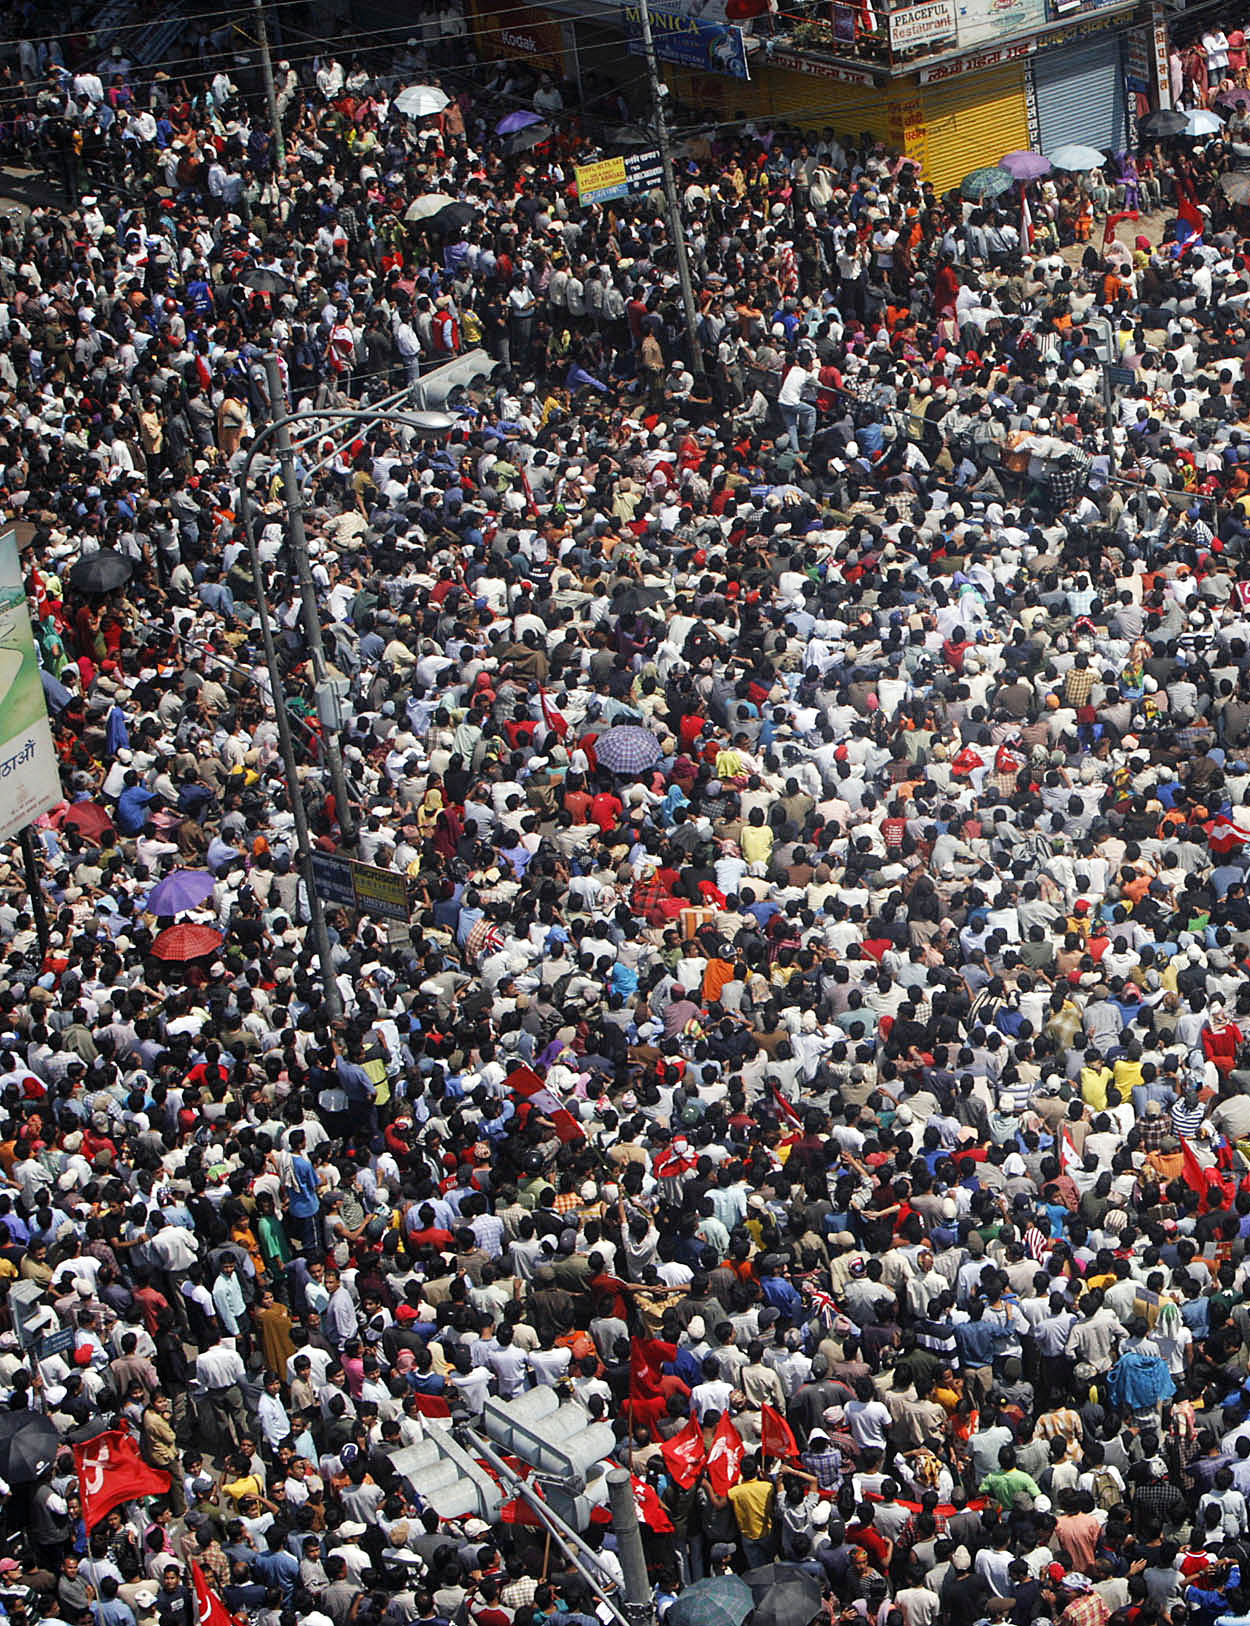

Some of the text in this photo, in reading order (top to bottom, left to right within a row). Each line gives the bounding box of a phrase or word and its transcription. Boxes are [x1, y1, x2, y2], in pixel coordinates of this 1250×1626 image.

[895, 3, 948, 27] PEACEFUL
[893, 14, 952, 41] Restaurant
[501, 31, 537, 52] Kodak
